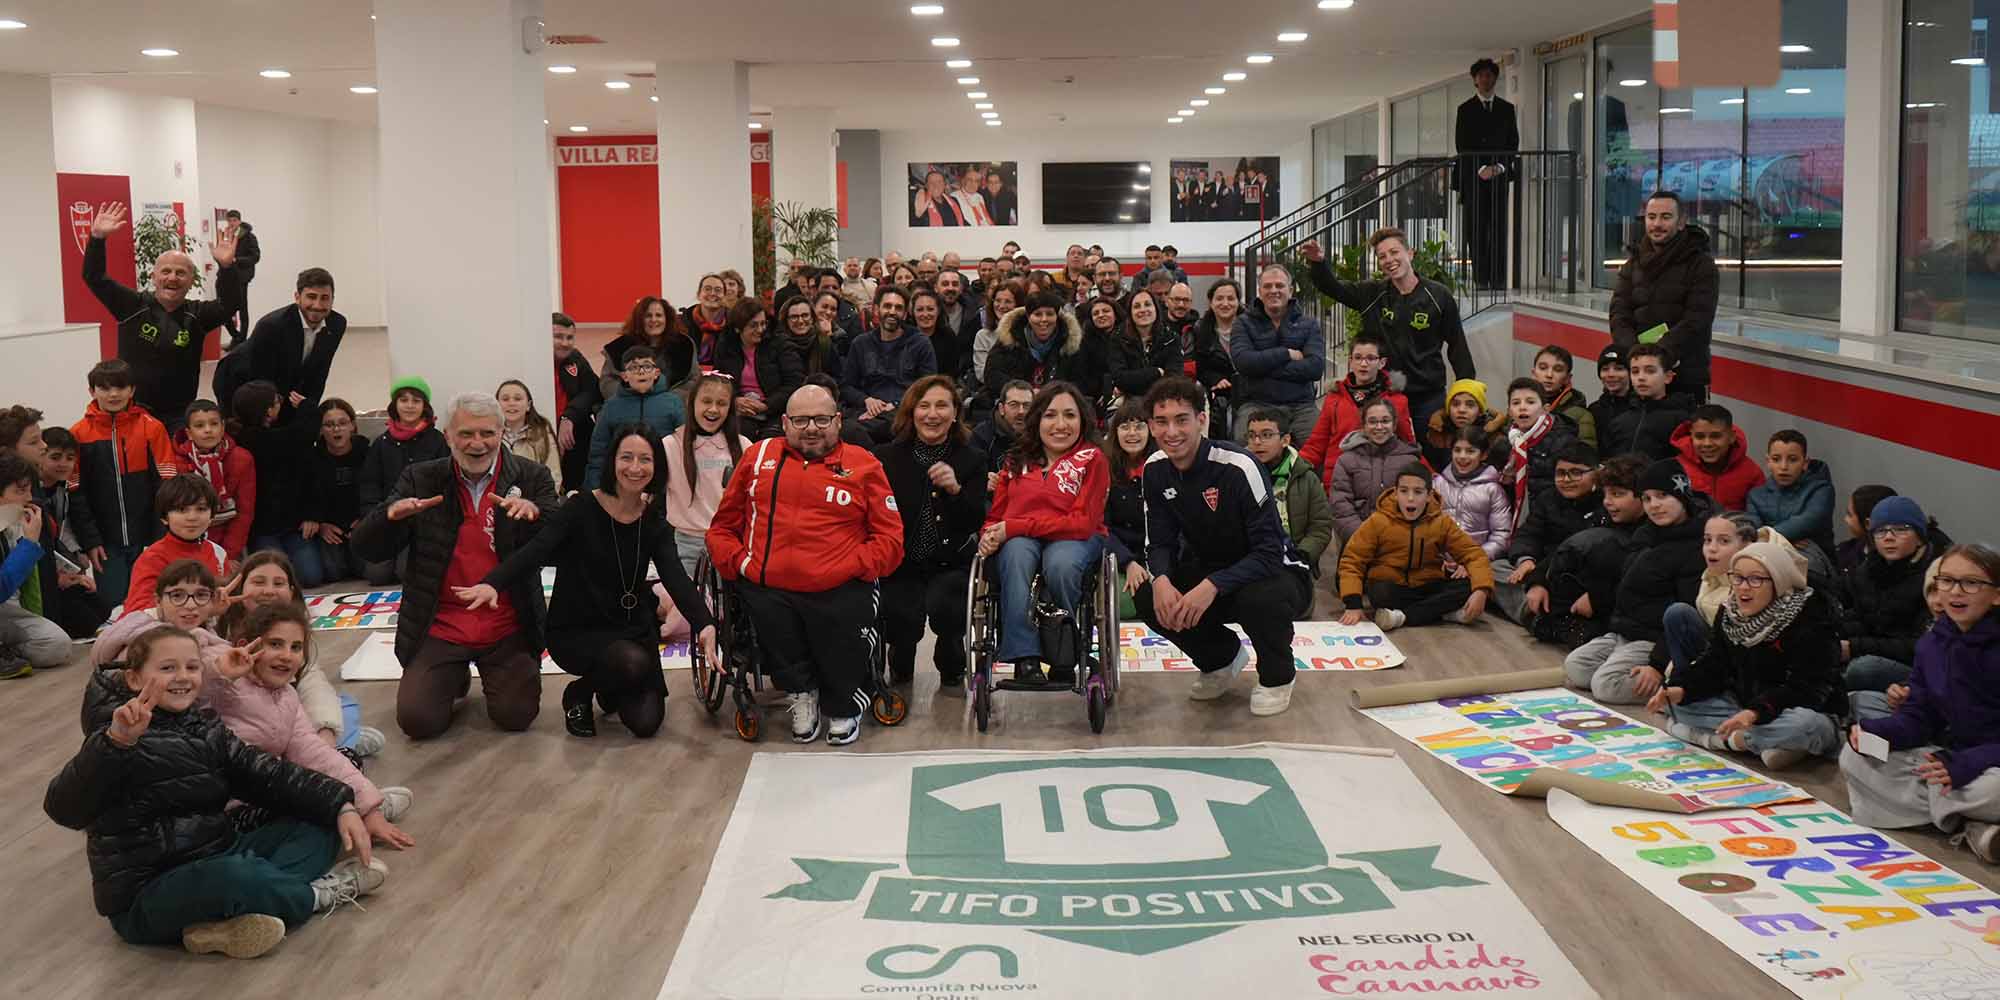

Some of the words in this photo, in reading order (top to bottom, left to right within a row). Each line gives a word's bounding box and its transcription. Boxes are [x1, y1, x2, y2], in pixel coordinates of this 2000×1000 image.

[559, 147, 619, 163] VILLA
[826, 486, 851, 506] 10
[1437, 695, 1537, 730] ENZA
[1687, 816, 1923, 931] FORZA
[909, 889, 1039, 918] TIFO
[1061, 882, 1345, 918] POSITIVO
[1297, 935, 1349, 946] NEL
[1353, 932, 1443, 945] SEGNO
[1447, 931, 1475, 942] DI
[1309, 943, 1526, 974] Candido
[860, 982, 965, 994] Comunità
[970, 982, 1039, 992] Nuova
[1317, 968, 1541, 996] Cannavò
